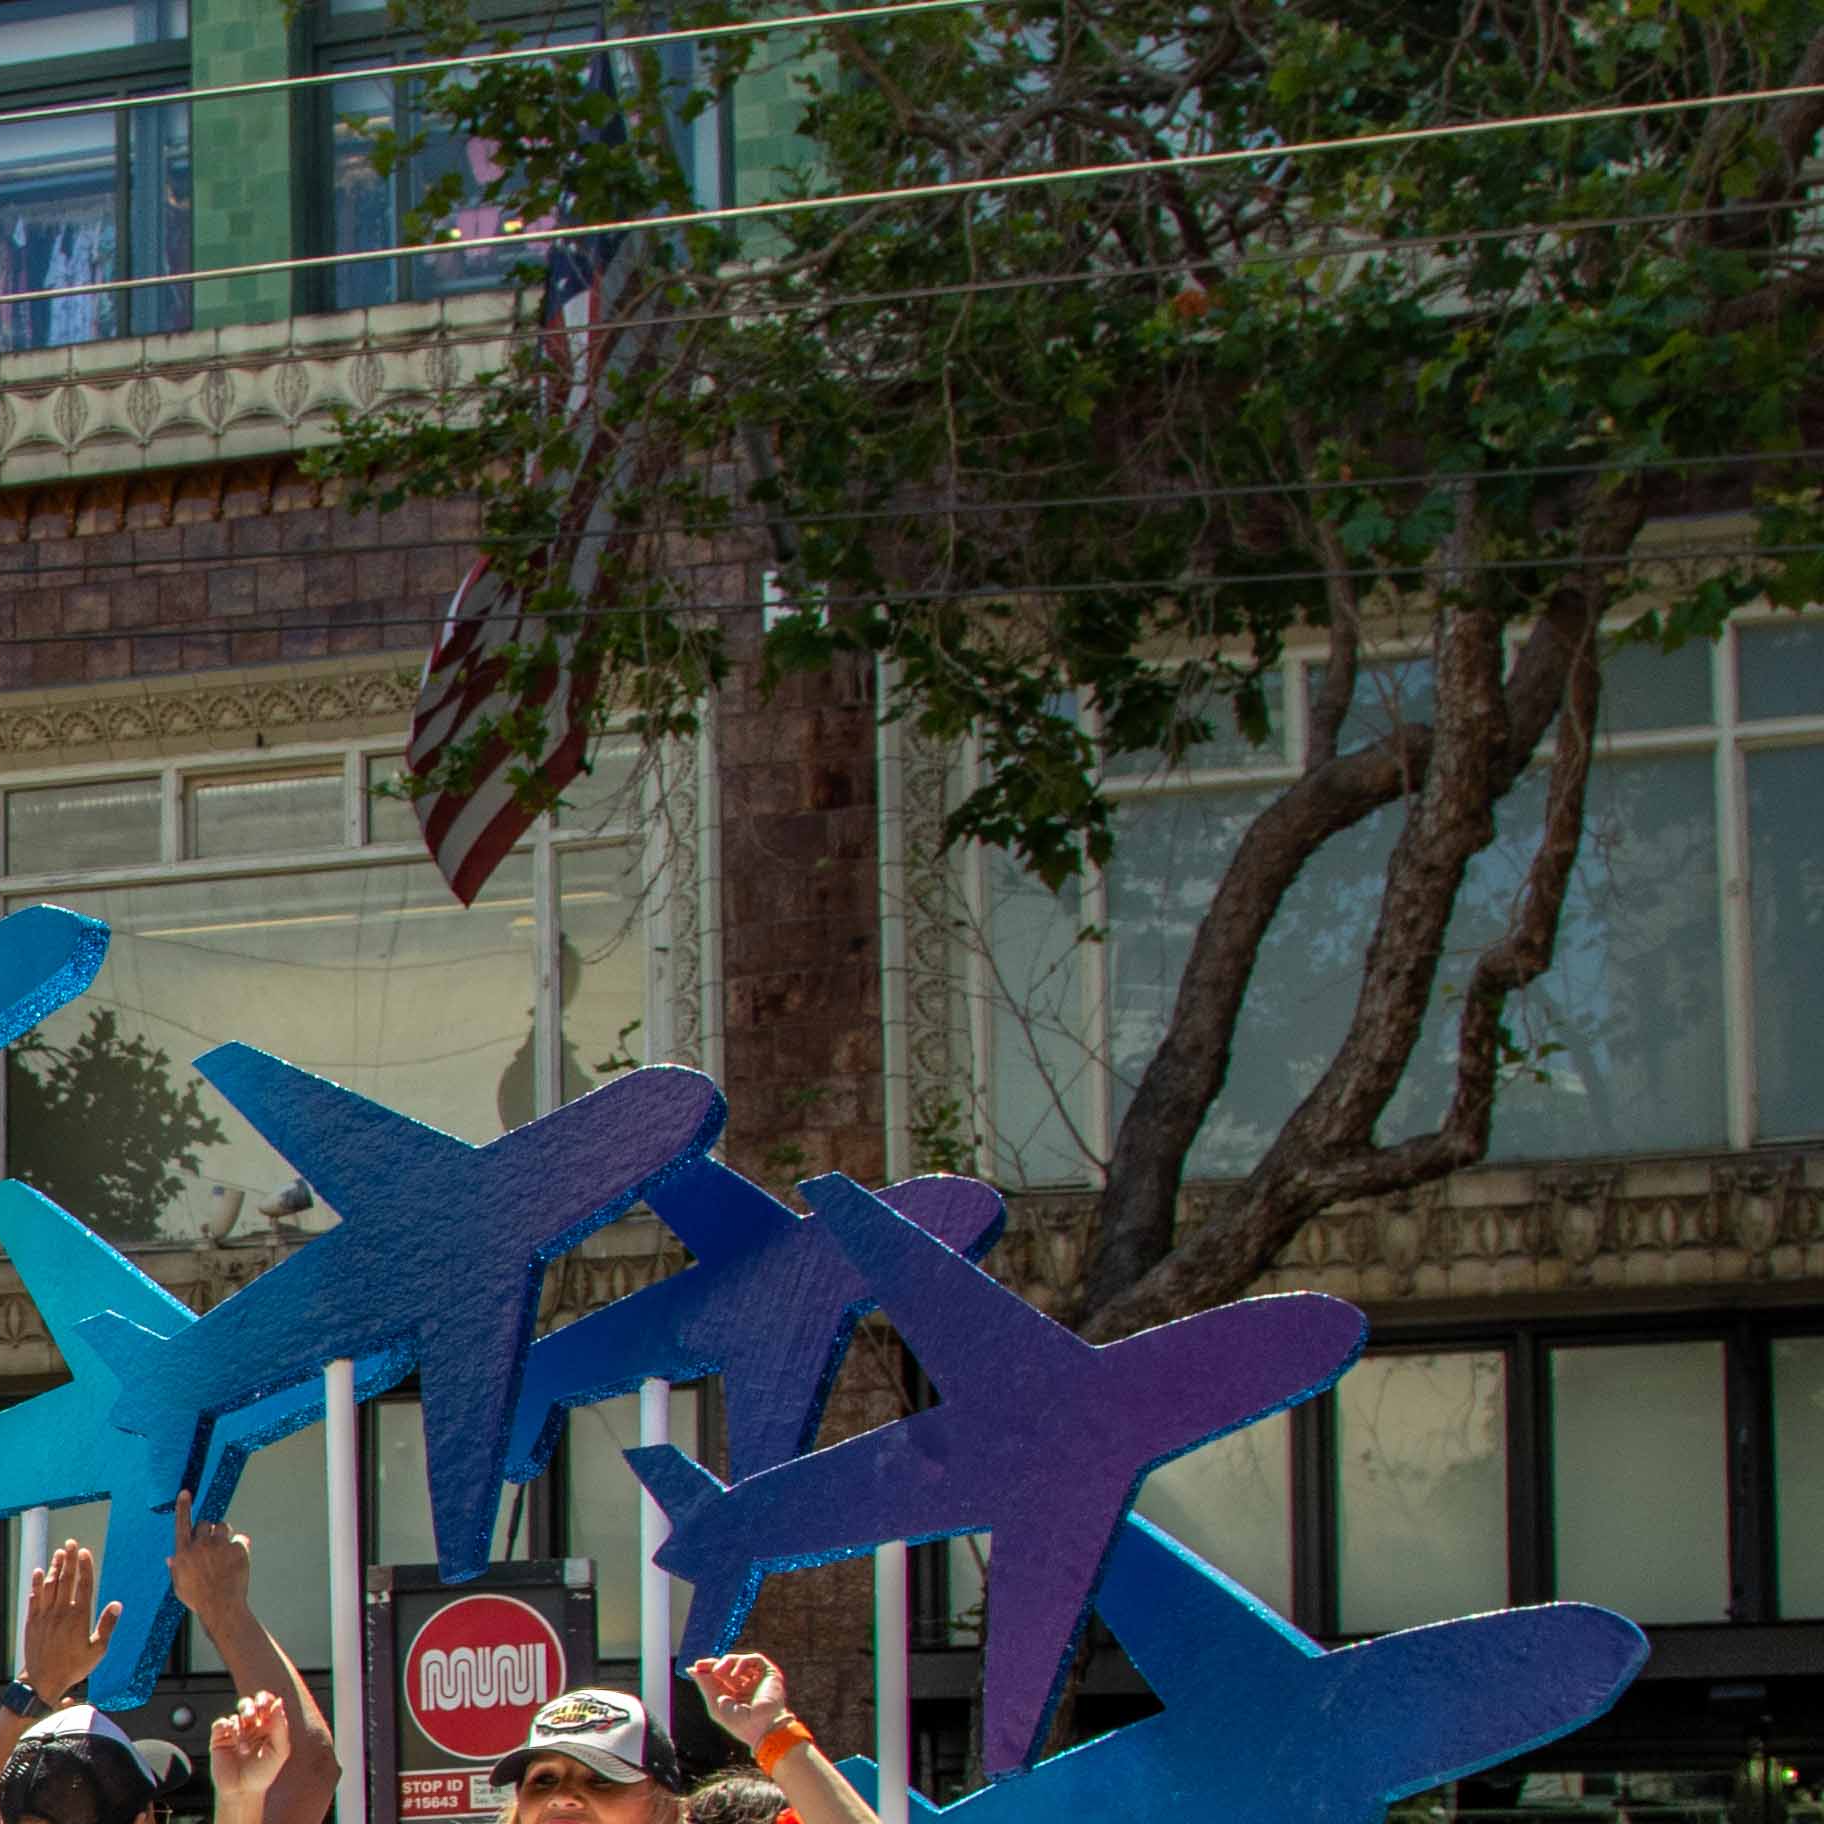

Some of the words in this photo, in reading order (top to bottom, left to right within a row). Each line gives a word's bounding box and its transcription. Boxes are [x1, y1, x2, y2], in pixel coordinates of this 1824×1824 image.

[421, 1643, 547, 1711] MUNI
[402, 1780, 443, 1795] STOP
[447, 1779, 464, 1792] ID
[402, 1795, 459, 1809] #15643
